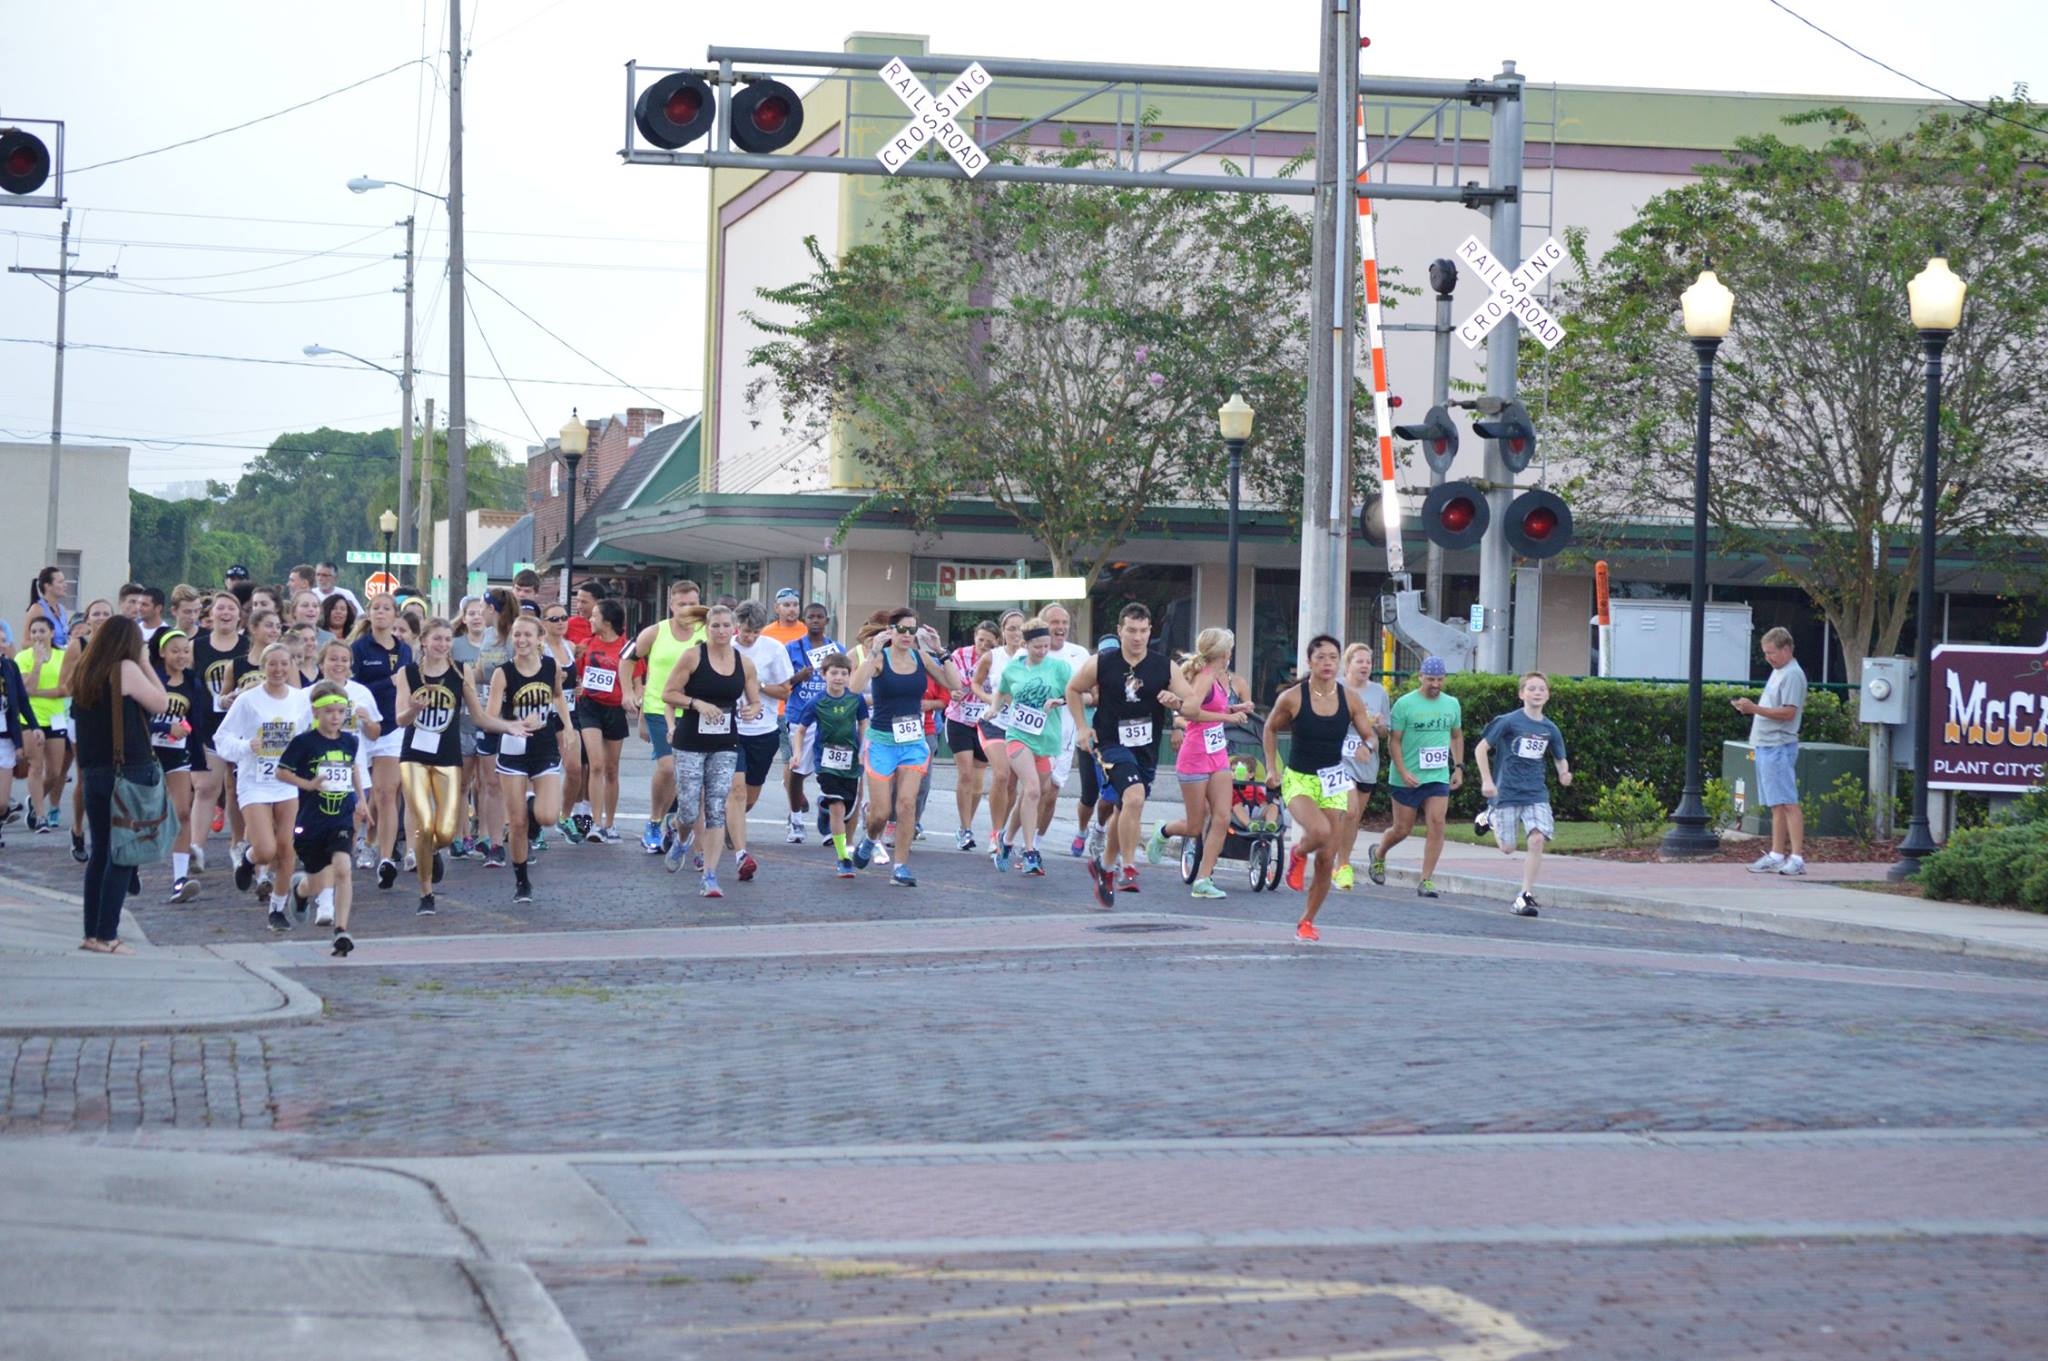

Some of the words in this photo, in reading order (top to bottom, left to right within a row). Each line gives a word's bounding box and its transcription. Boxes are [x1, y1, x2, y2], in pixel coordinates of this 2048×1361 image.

[883, 69, 985, 166] CROSSING
[885, 63, 981, 169] RAILROAD
[1462, 241, 1558, 341] RAILROAD
[1462, 244, 1560, 342] CROSSING
[588, 672, 613, 686] 269
[1016, 710, 1044, 729] 300
[898, 722, 917, 734] 362
[1125, 726, 1147, 738] 351
[828, 750, 848, 762] 382
[1425, 751, 1448, 763] 095
[326, 768, 348, 781] 353
[1934, 760, 1989, 775] PLANT
[1993, 762, 2045, 777] CITY'S
